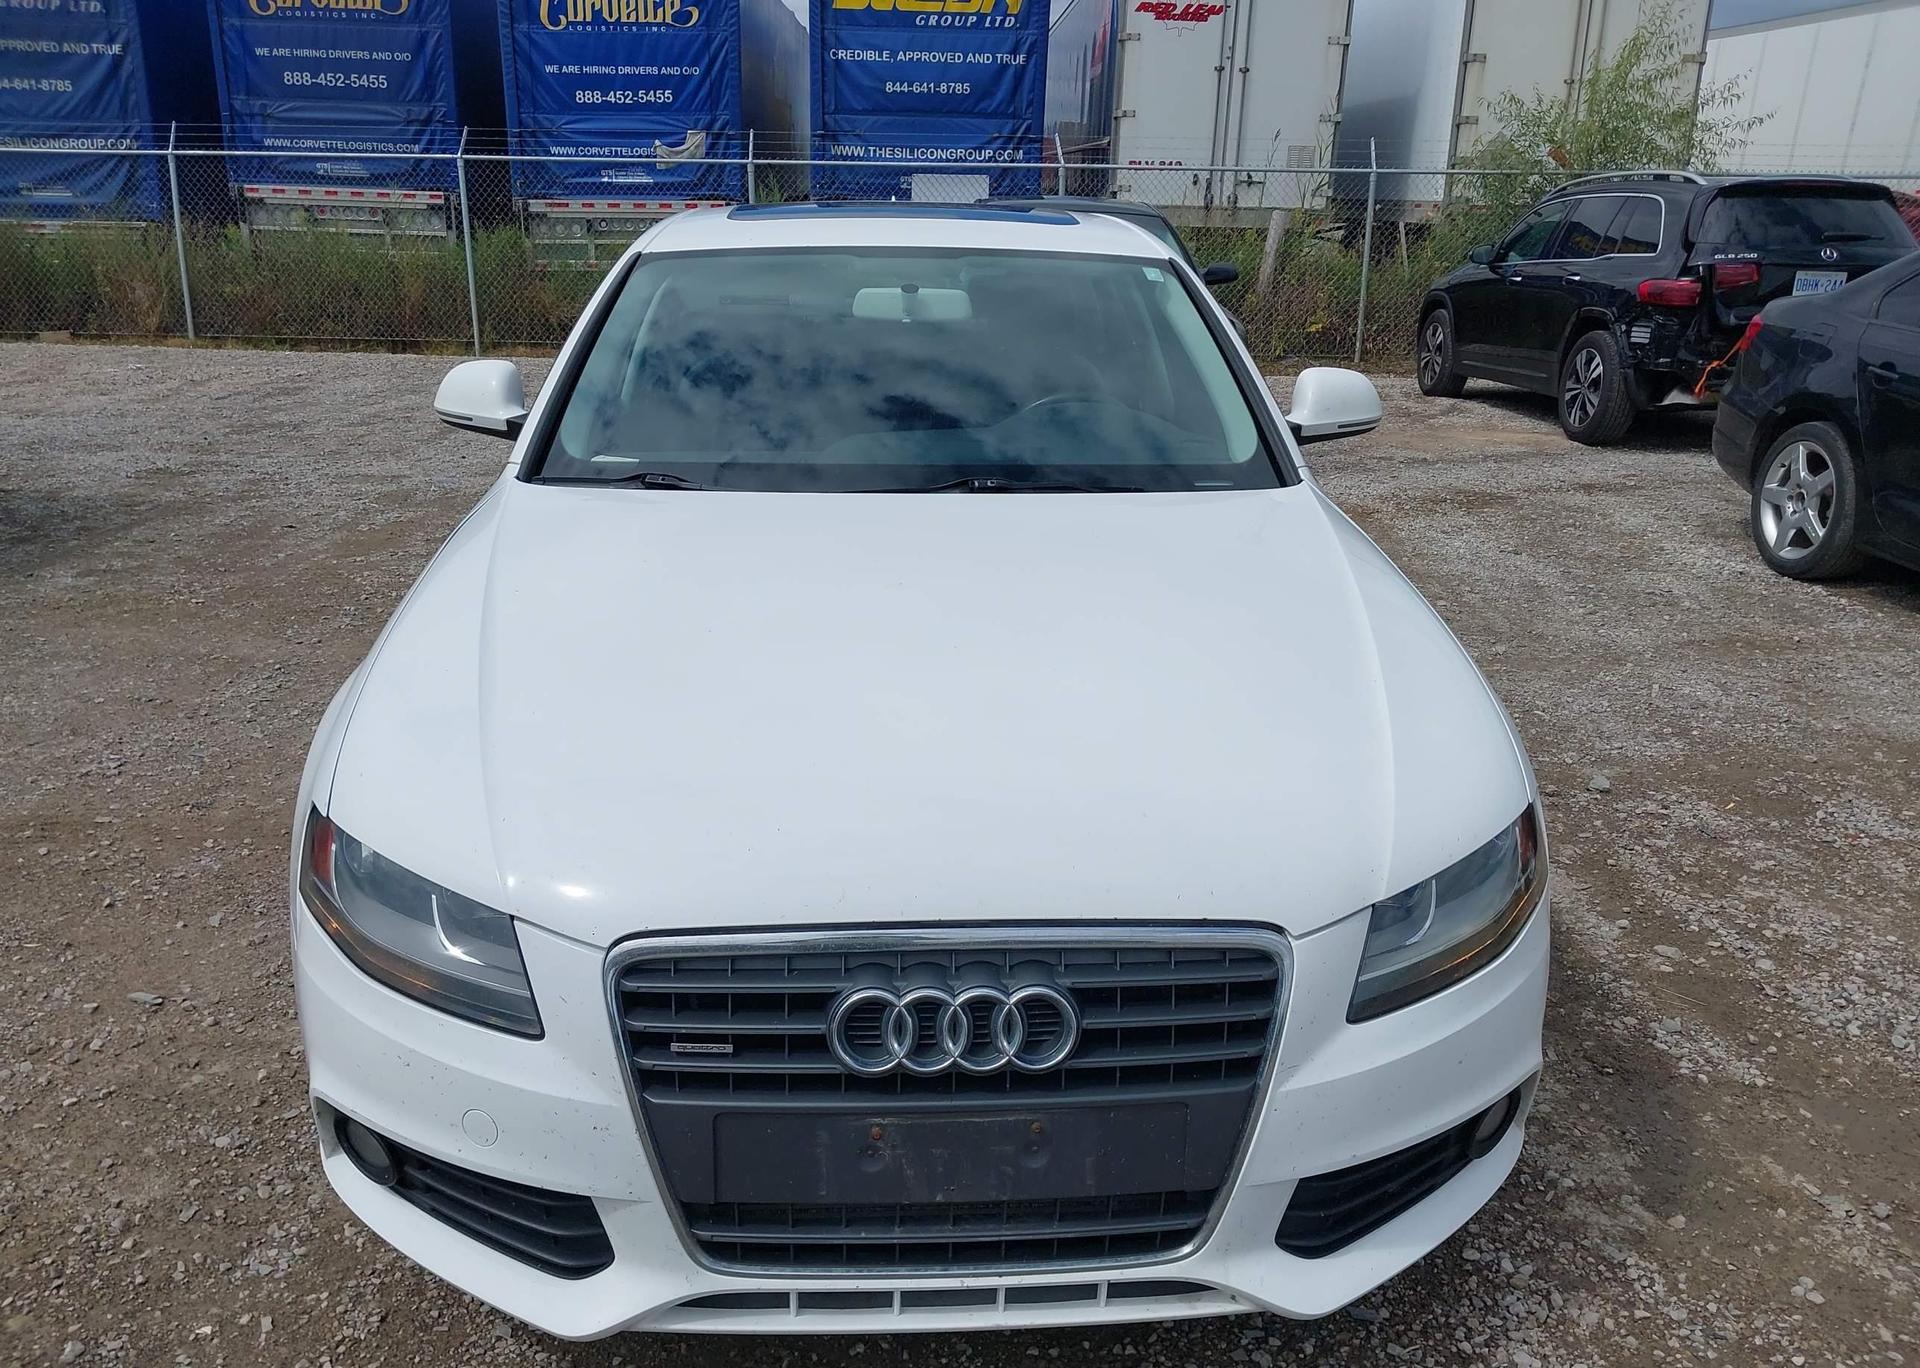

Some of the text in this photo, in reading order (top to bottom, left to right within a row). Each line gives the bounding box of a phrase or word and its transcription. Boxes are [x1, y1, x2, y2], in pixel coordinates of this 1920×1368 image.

[1134, 1, 1177, 13] RED
[278, 10, 384, 20] LOGISTICS INC.
[915, 14, 1021, 28] GROUP LTD.
[62, 42, 89, 54] AND
[91, 43, 124, 55] TRUE
[255, 47, 412, 61] WE ARE HIRING DRIVERS AND O/O
[829, 49, 1027, 65] CREDIBLE, APPROVED AND TRUE
[545, 64, 700, 76] WE ARE HIRING DRIVERS AND O/O
[0, 78, 73, 92] 4-641-8785
[283, 71, 388, 89] 888-452-5455
[885, 81, 971, 94] 844-641-8785
[575, 89, 673, 104] 888-452-5455
[263, 137, 419, 152] WWW.CORVETTELOGISTICS.COM
[830, 144, 1024, 160] WWW.THESILICONGROUP.COM
